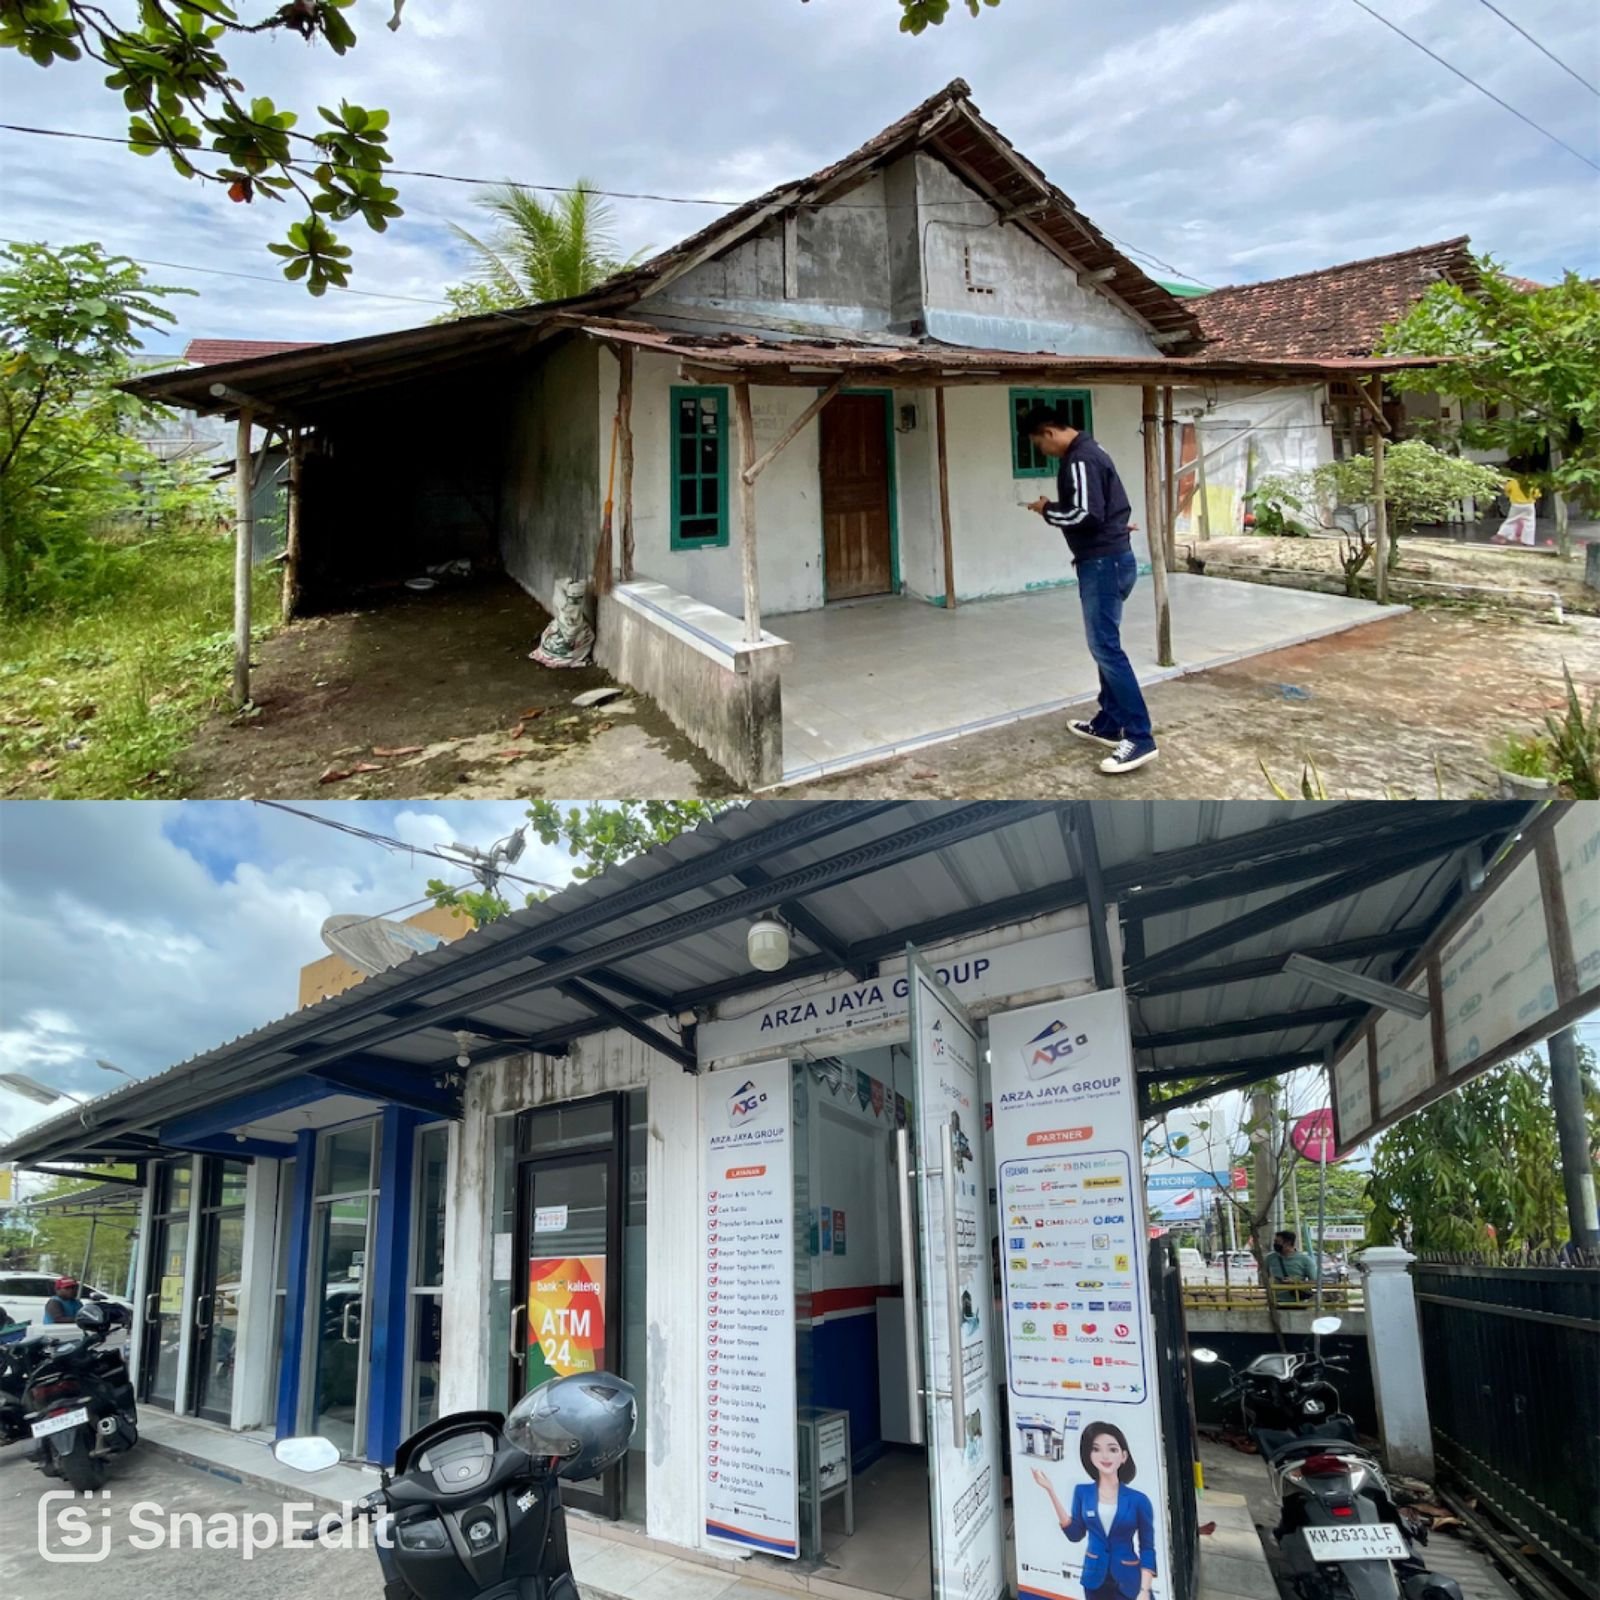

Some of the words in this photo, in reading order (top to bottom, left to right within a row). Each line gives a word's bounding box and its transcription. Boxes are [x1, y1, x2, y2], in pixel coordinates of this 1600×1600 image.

[760, 1002, 818, 1031] ARZA
[826, 985, 884, 1015] JAYA
[892, 957, 990, 999] GOUP
[1000, 1090, 1034, 1103] ARZA
[1036, 1085, 1068, 1098] JAYA
[1072, 1076, 1121, 1093] GROUP
[710, 1136, 732, 1145] ARZA
[733, 1132, 753, 1142] JAYA
[755, 1128, 784, 1138] GROUP
[1036, 1130, 1083, 1143] PARTNER
[537, 1280, 558, 1292] bank
[567, 1280, 601, 1296] kalteng
[541, 1309, 591, 1338] ATM
[544, 1338, 571, 1367] 24
[1309, 1529, 1330, 1543] KH
[1331, 1528, 1369, 1543] 2633
[1373, 1527, 1393, 1541] LF
